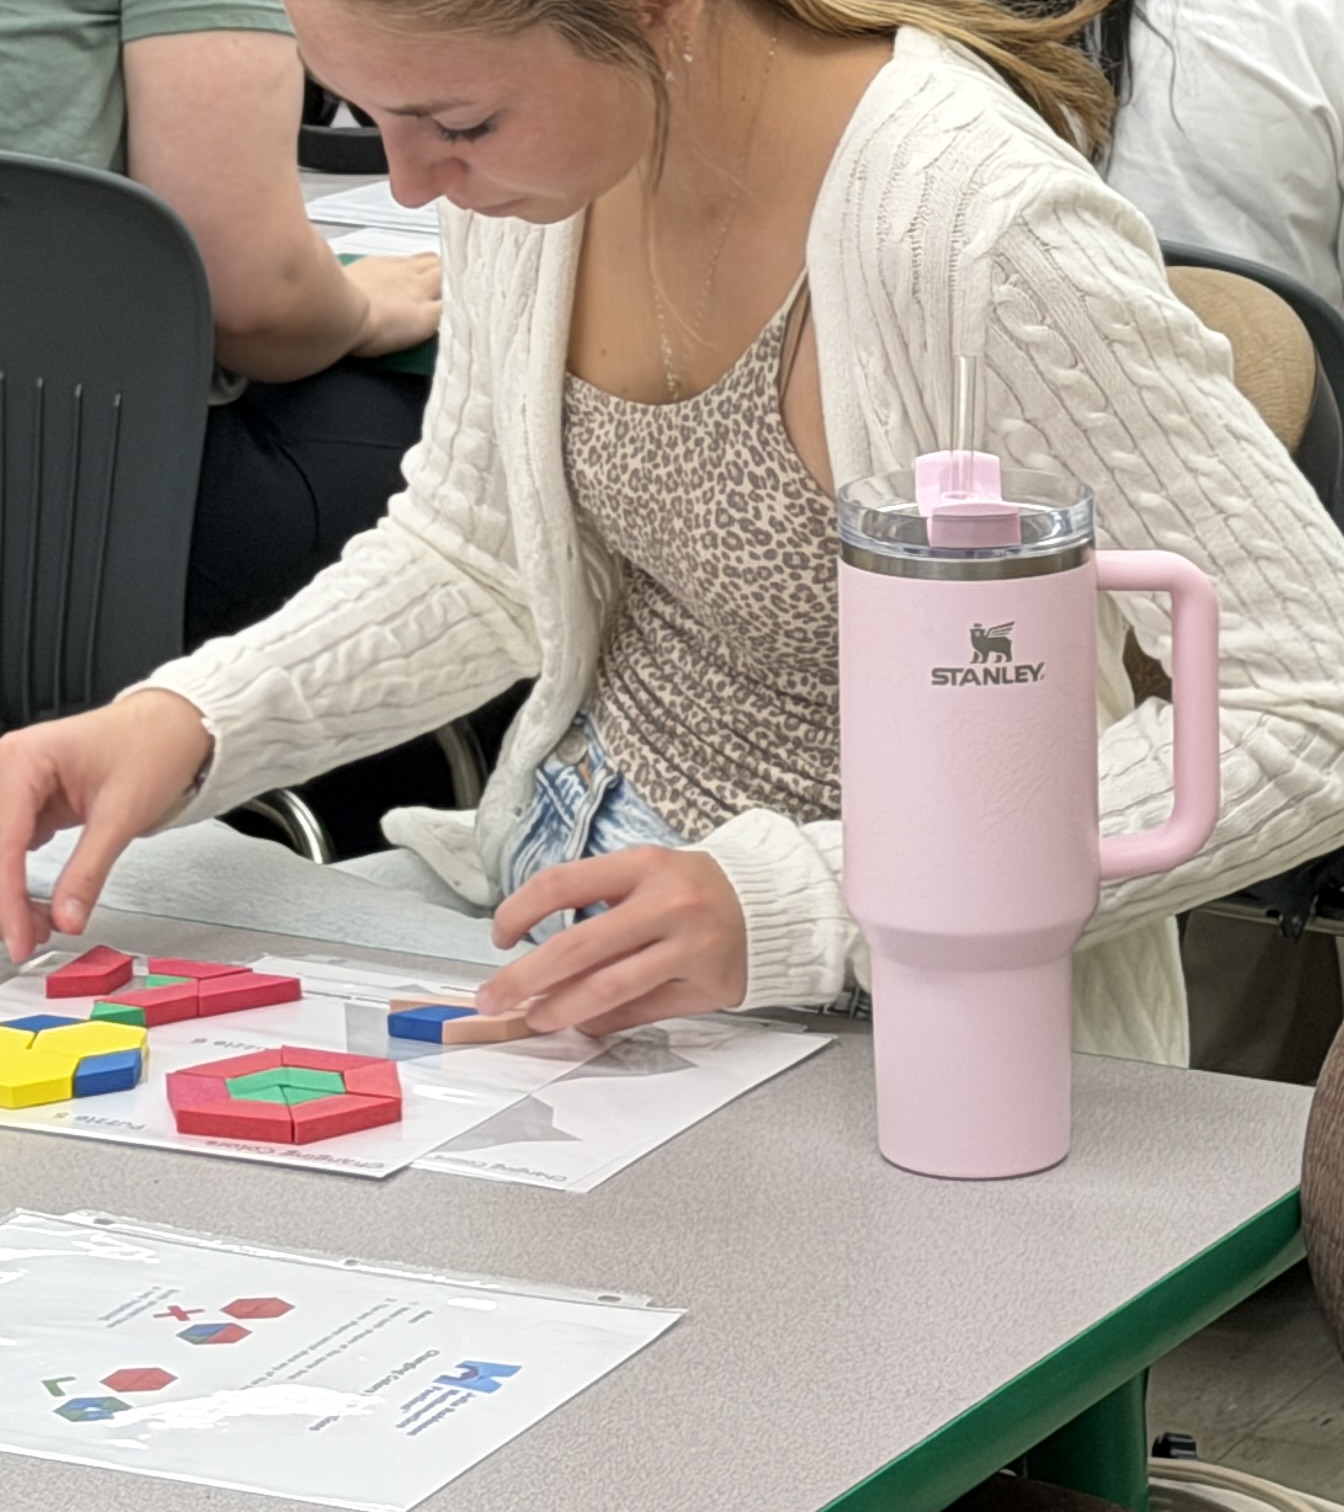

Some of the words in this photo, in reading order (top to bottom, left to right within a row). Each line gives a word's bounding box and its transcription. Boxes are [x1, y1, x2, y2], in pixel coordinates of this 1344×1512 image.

[930, 661, 1045, 687] STANLEY
[75, 1115, 146, 1132] Puzzle
[207, 1139, 275, 1155] Colors
[282, 1148, 385, 1170] Changing
